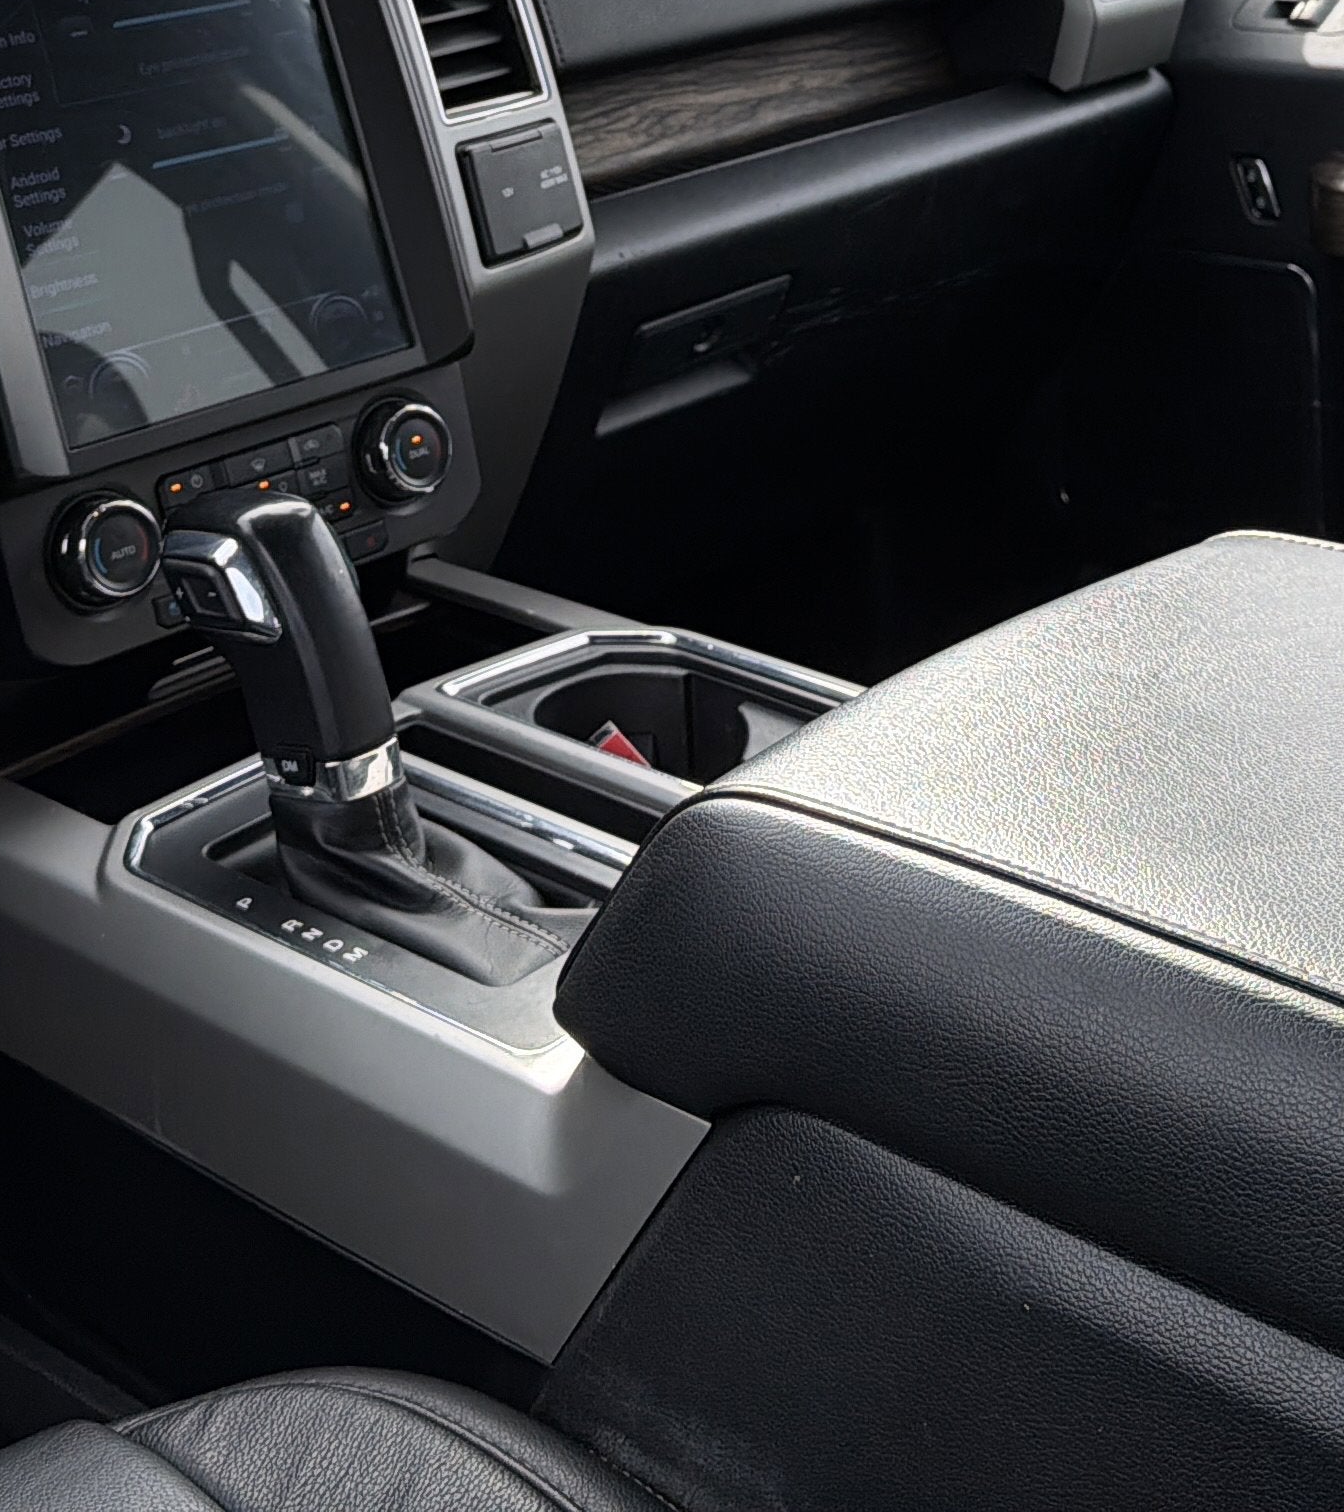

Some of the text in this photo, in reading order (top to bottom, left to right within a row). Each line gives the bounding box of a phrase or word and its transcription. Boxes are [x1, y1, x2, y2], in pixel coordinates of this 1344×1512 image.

[8, 29, 37, 46] Info
[9, 127, 64, 148] Settings
[10, 168, 61, 189] Android
[13, 187, 67, 208] Settings
[111, 544, 137, 561] AUTO
